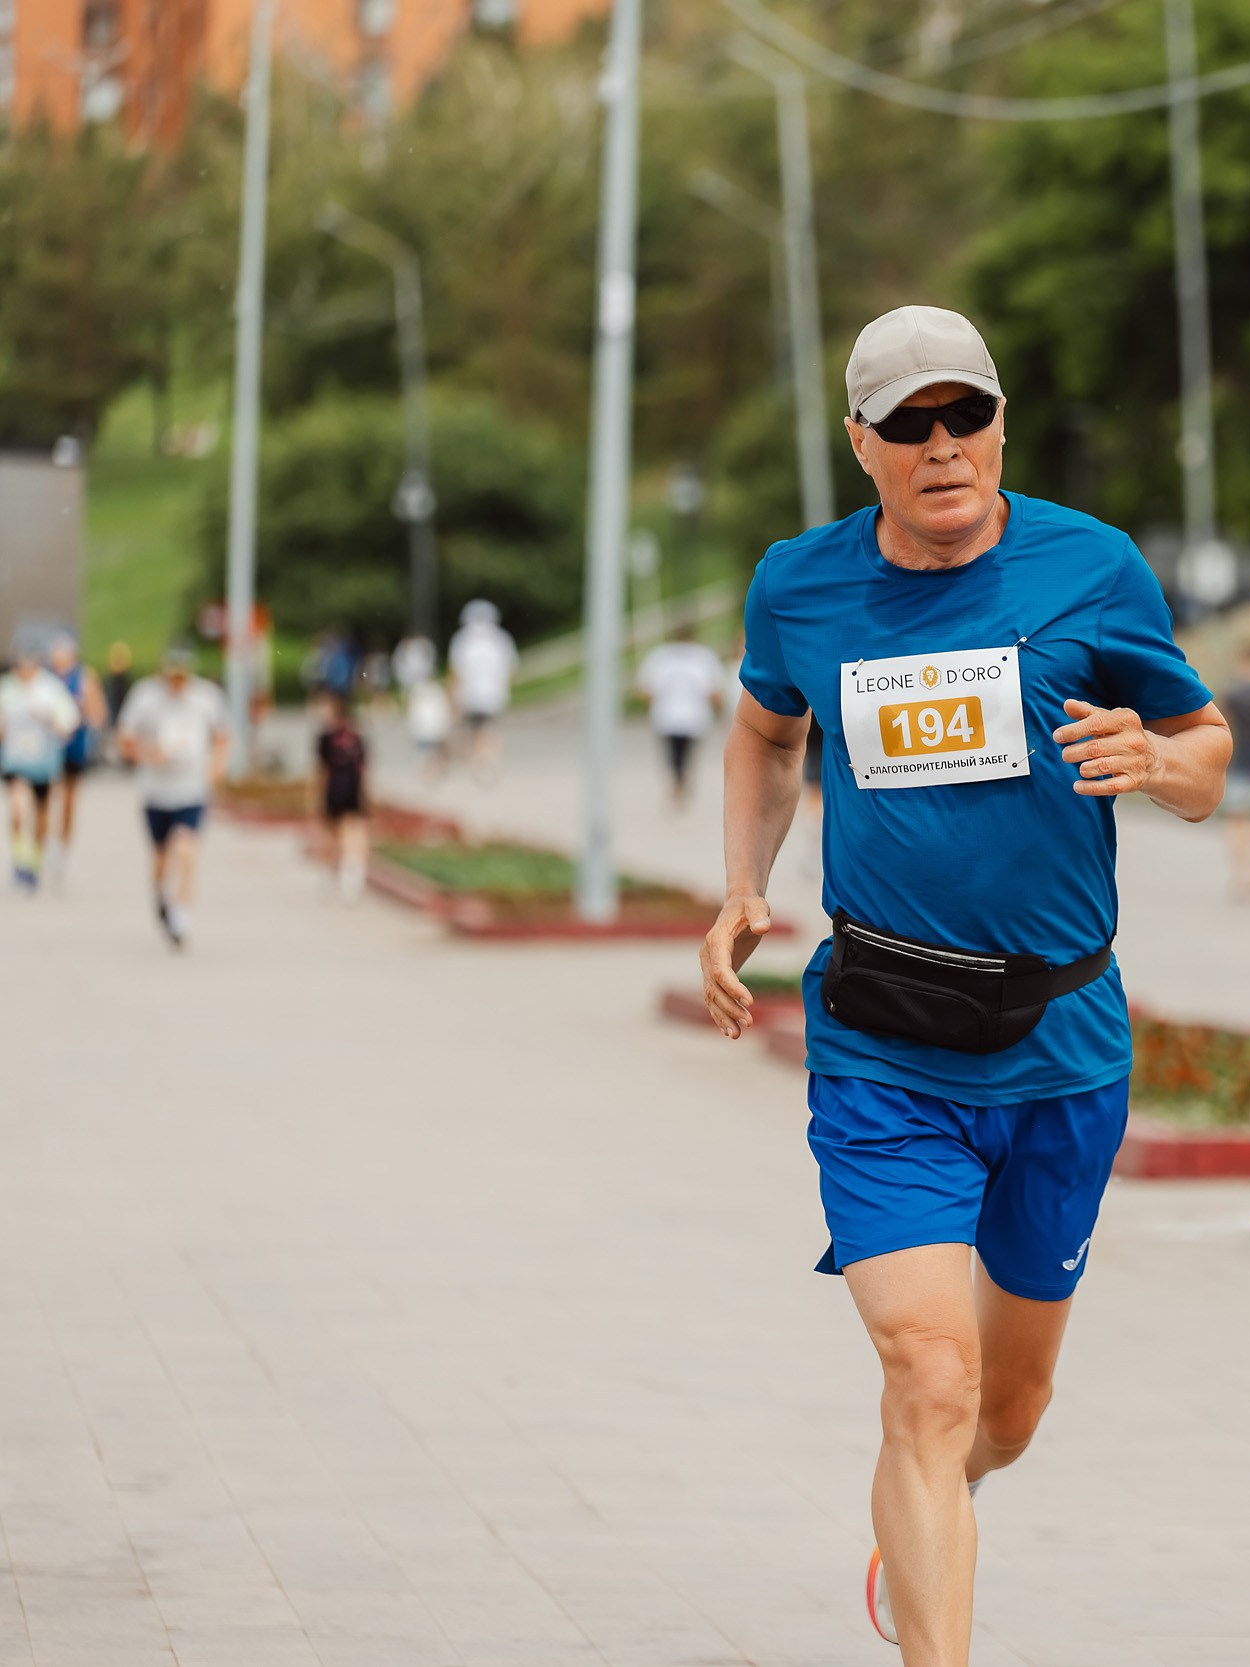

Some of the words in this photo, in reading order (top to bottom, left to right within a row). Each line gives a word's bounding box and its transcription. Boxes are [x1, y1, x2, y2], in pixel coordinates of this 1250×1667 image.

[856, 673, 915, 694] LEONE
[946, 665, 1002, 684] D'ORO
[891, 703, 974, 749] 194
[869, 756, 977, 775] БЛАГОТВОРИТЕЛЬНЫЙ
[978, 754, 1009, 766] ЗАБЕГ
